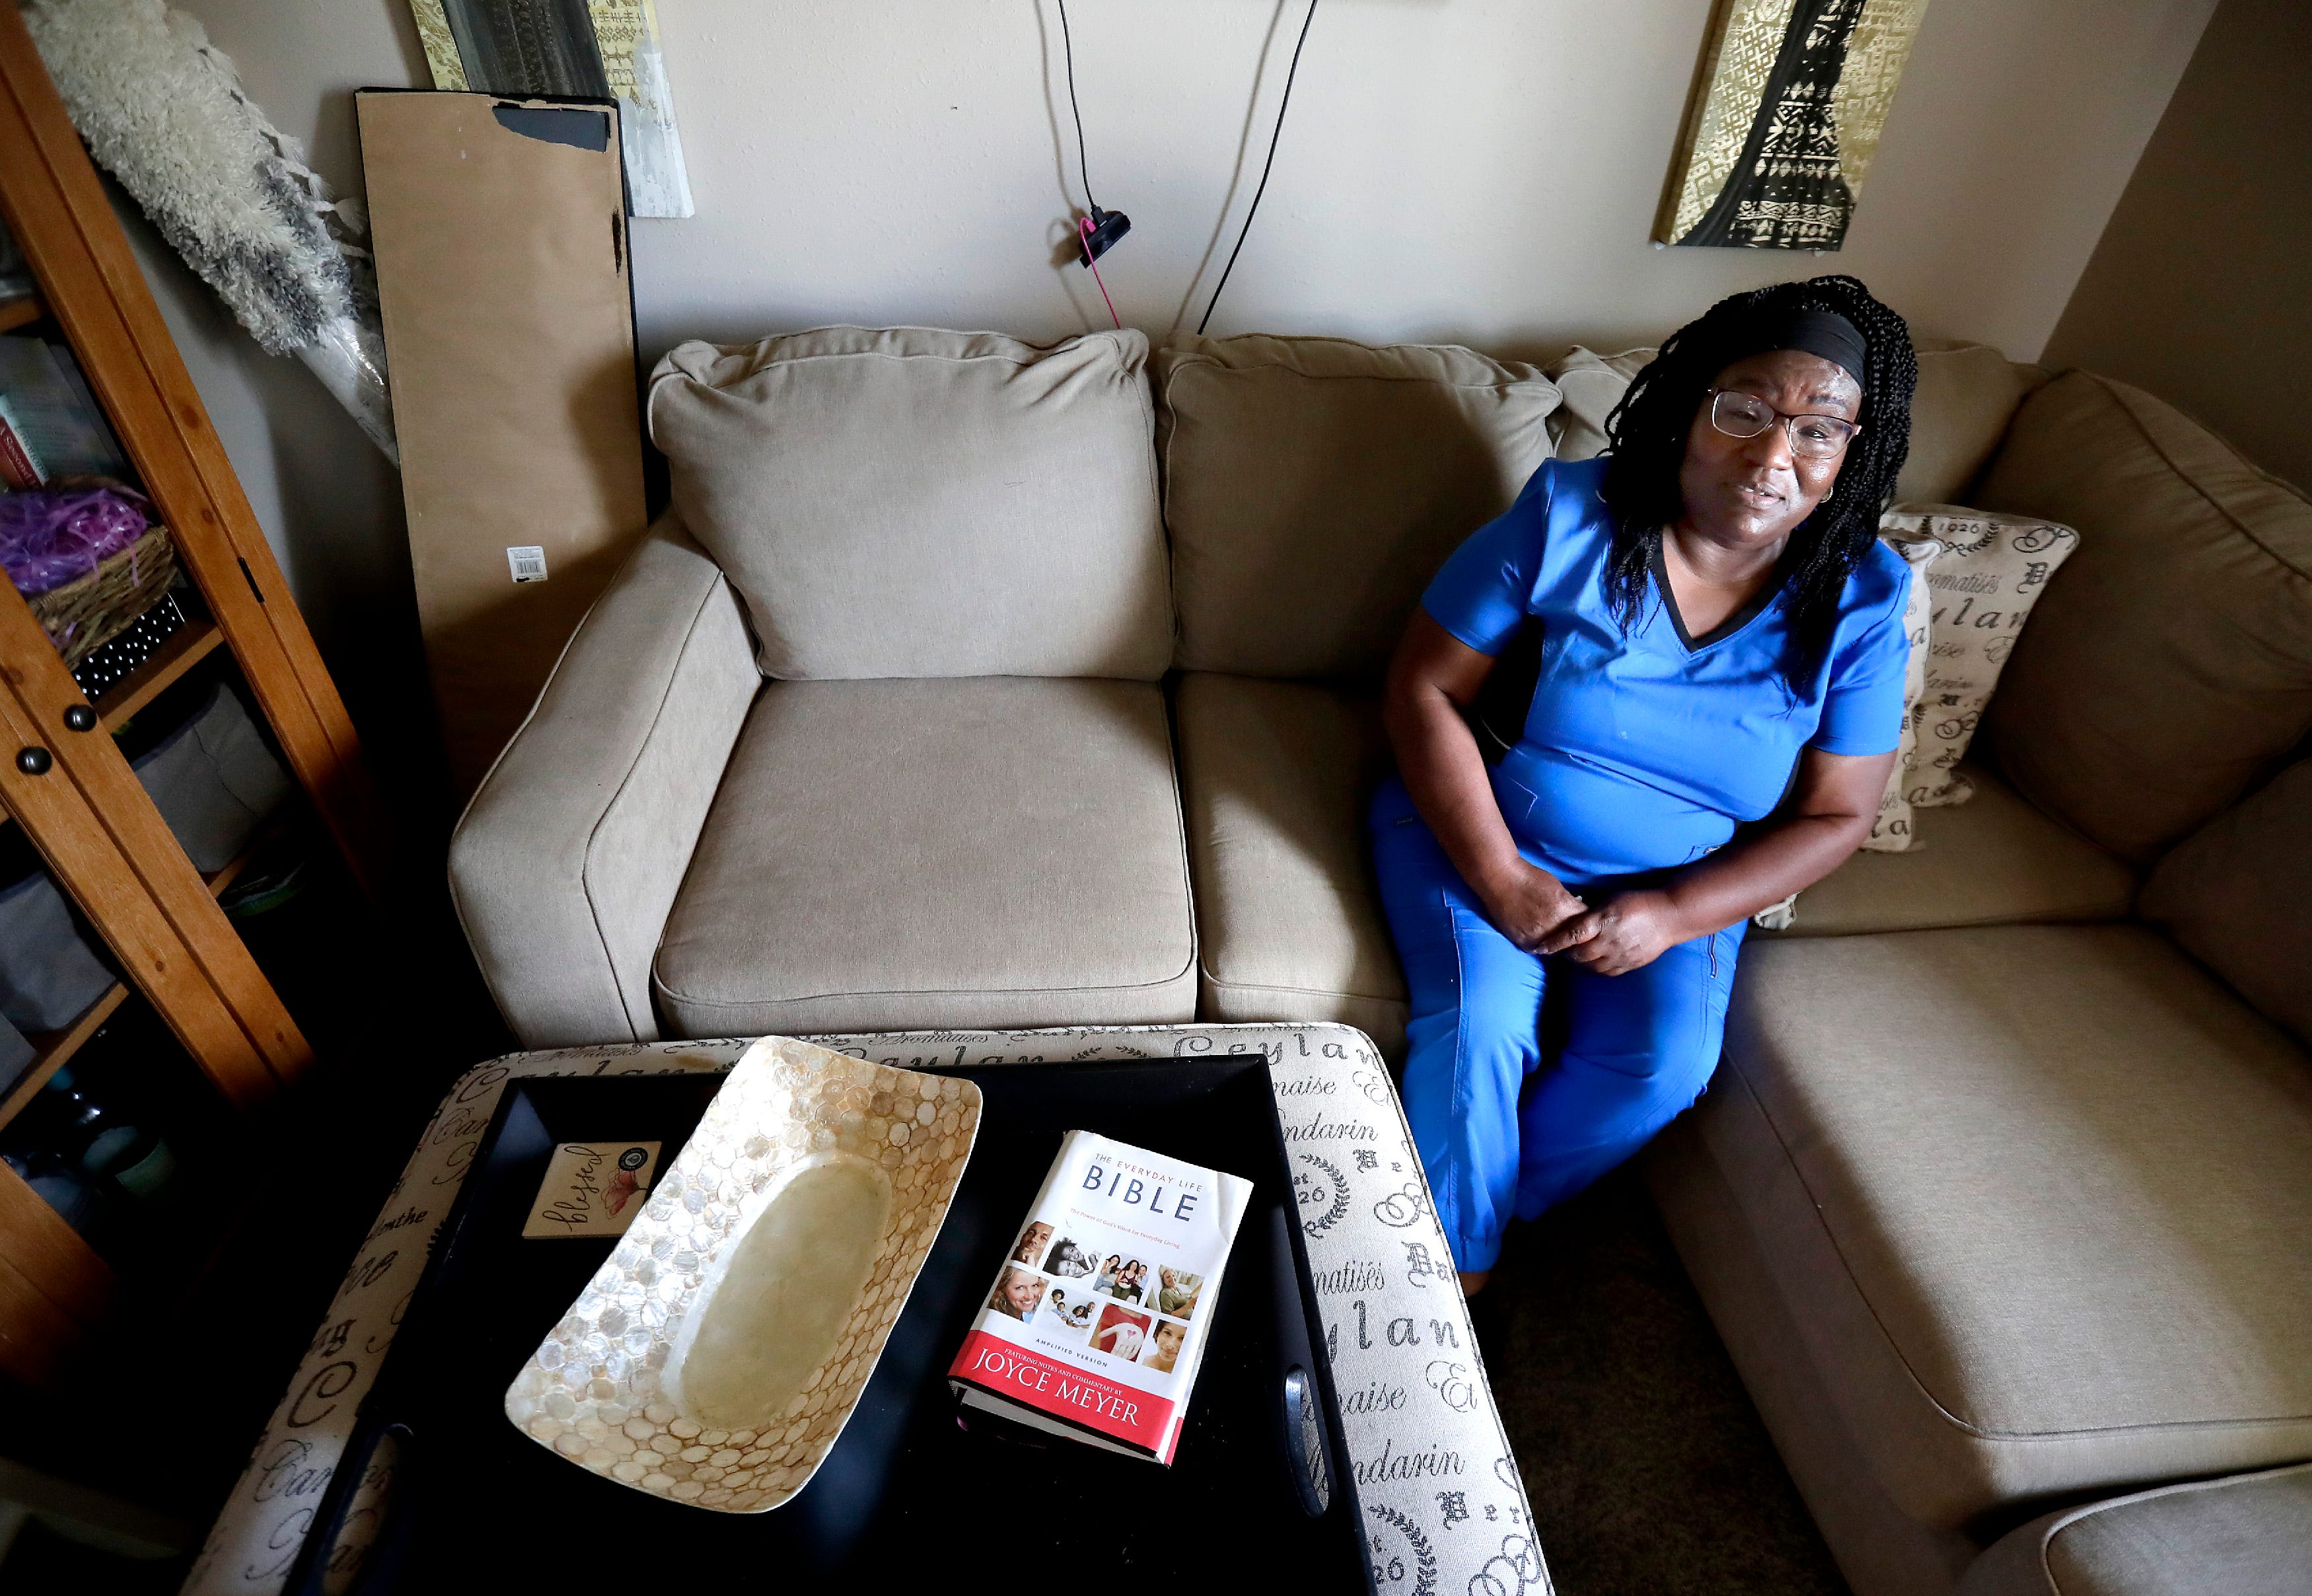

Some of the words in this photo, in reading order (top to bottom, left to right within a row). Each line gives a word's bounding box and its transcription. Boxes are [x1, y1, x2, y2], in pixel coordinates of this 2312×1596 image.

[542, 1145, 611, 1232] blessed
[1082, 1165, 1198, 1222] BIBLE
[1095, 1153, 1112, 1164] THE
[1117, 1161, 1174, 1184] EVERYDAY
[1179, 1180, 1203, 1192] LIFE
[1080, 1211, 1095, 1221] Power
[1103, 1219, 1116, 1229] God's
[1118, 1225, 1131, 1233] Word
[1140, 1232, 1163, 1244] Everyday
[1163, 1239, 1180, 1250] Living
[1004, 1348, 1038, 1365] FEATURING
[1038, 1361, 1058, 1373] NOTES
[1058, 1368, 1071, 1378] AND
[1072, 1374, 1114, 1393] COMMENTARY
[1036, 1338, 1073, 1355] AMPLIFIED
[1077, 1352, 1108, 1367] VERSION
[972, 1348, 1052, 1393] JOYCE
[1054, 1379, 1138, 1427] MEYER
